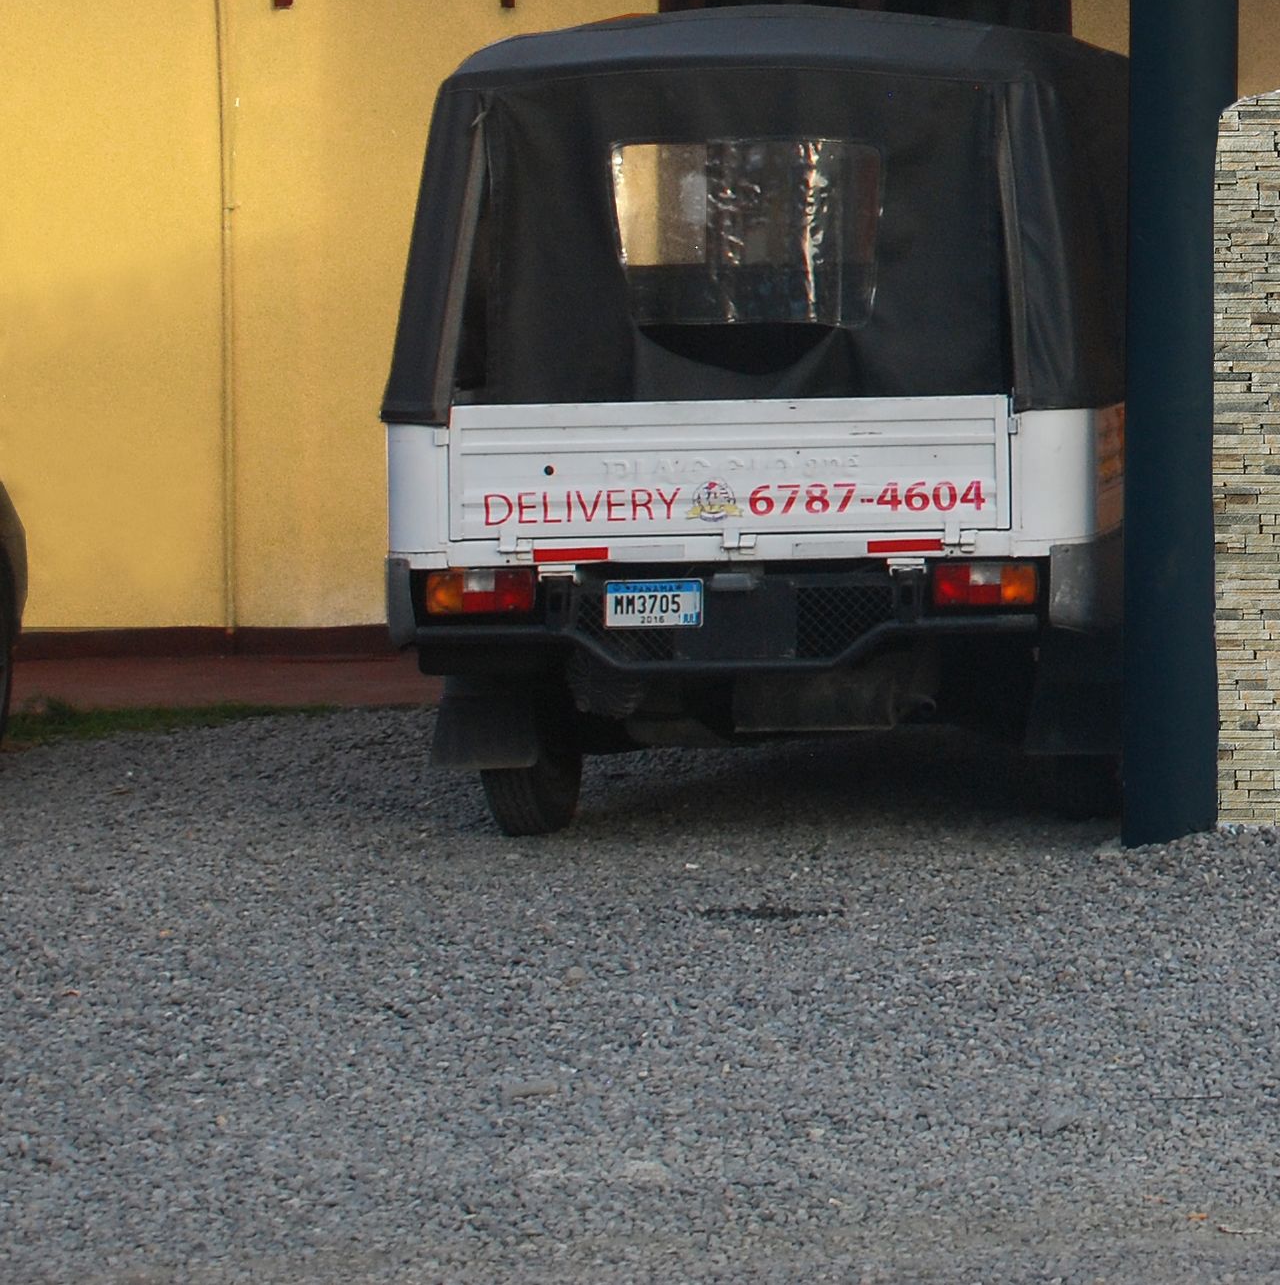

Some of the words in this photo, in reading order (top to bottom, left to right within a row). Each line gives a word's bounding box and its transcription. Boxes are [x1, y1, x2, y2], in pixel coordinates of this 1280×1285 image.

[483, 487, 681, 527] DELIVERY
[748, 480, 985, 515] 6787-4604
[614, 594, 680, 614] MM3705
